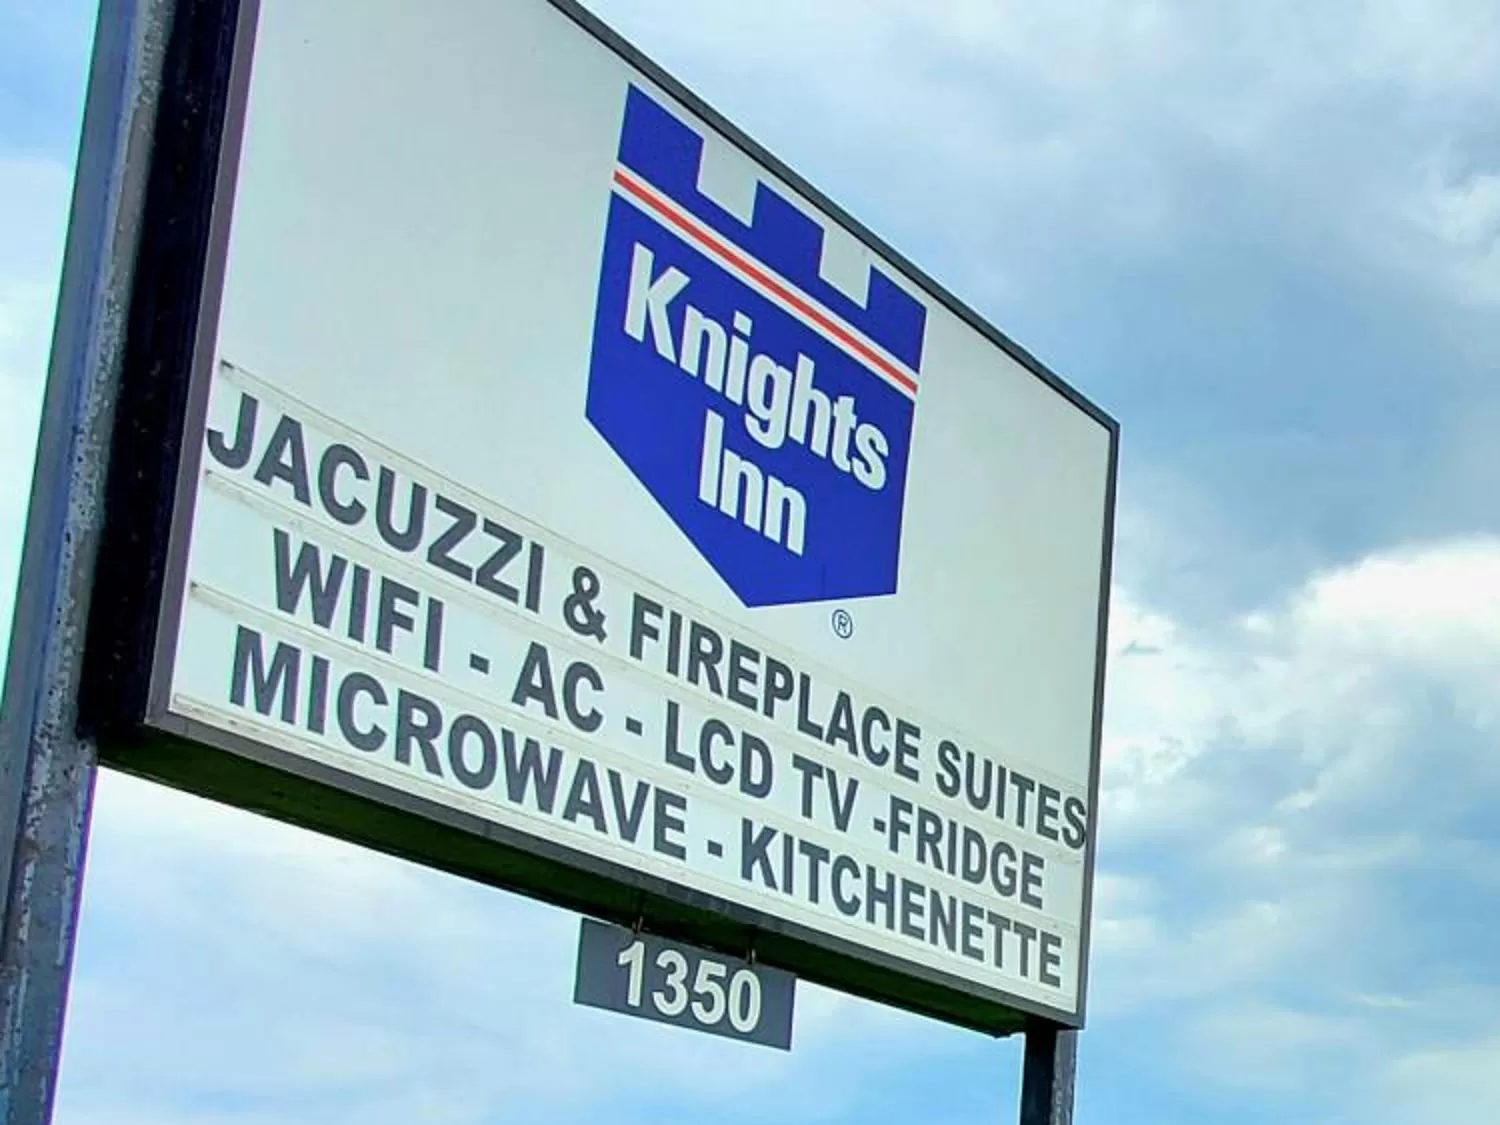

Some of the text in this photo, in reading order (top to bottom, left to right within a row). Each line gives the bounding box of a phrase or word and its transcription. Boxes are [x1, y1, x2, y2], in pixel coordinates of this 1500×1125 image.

[624, 241, 889, 491] Knights
[698, 408, 807, 558] Inn
[207, 392, 1087, 849] JACUZZI & FIREPLACE SUITES
[273, 527, 444, 673] WIFI
[511, 641, 604, 733] AC
[665, 699, 774, 799] LCD
[792, 753, 859, 832] TV
[230, 624, 687, 861] MICROWAVE
[741, 817, 1062, 988] KITCHENETTE
[618, 940, 762, 1033] 1350
